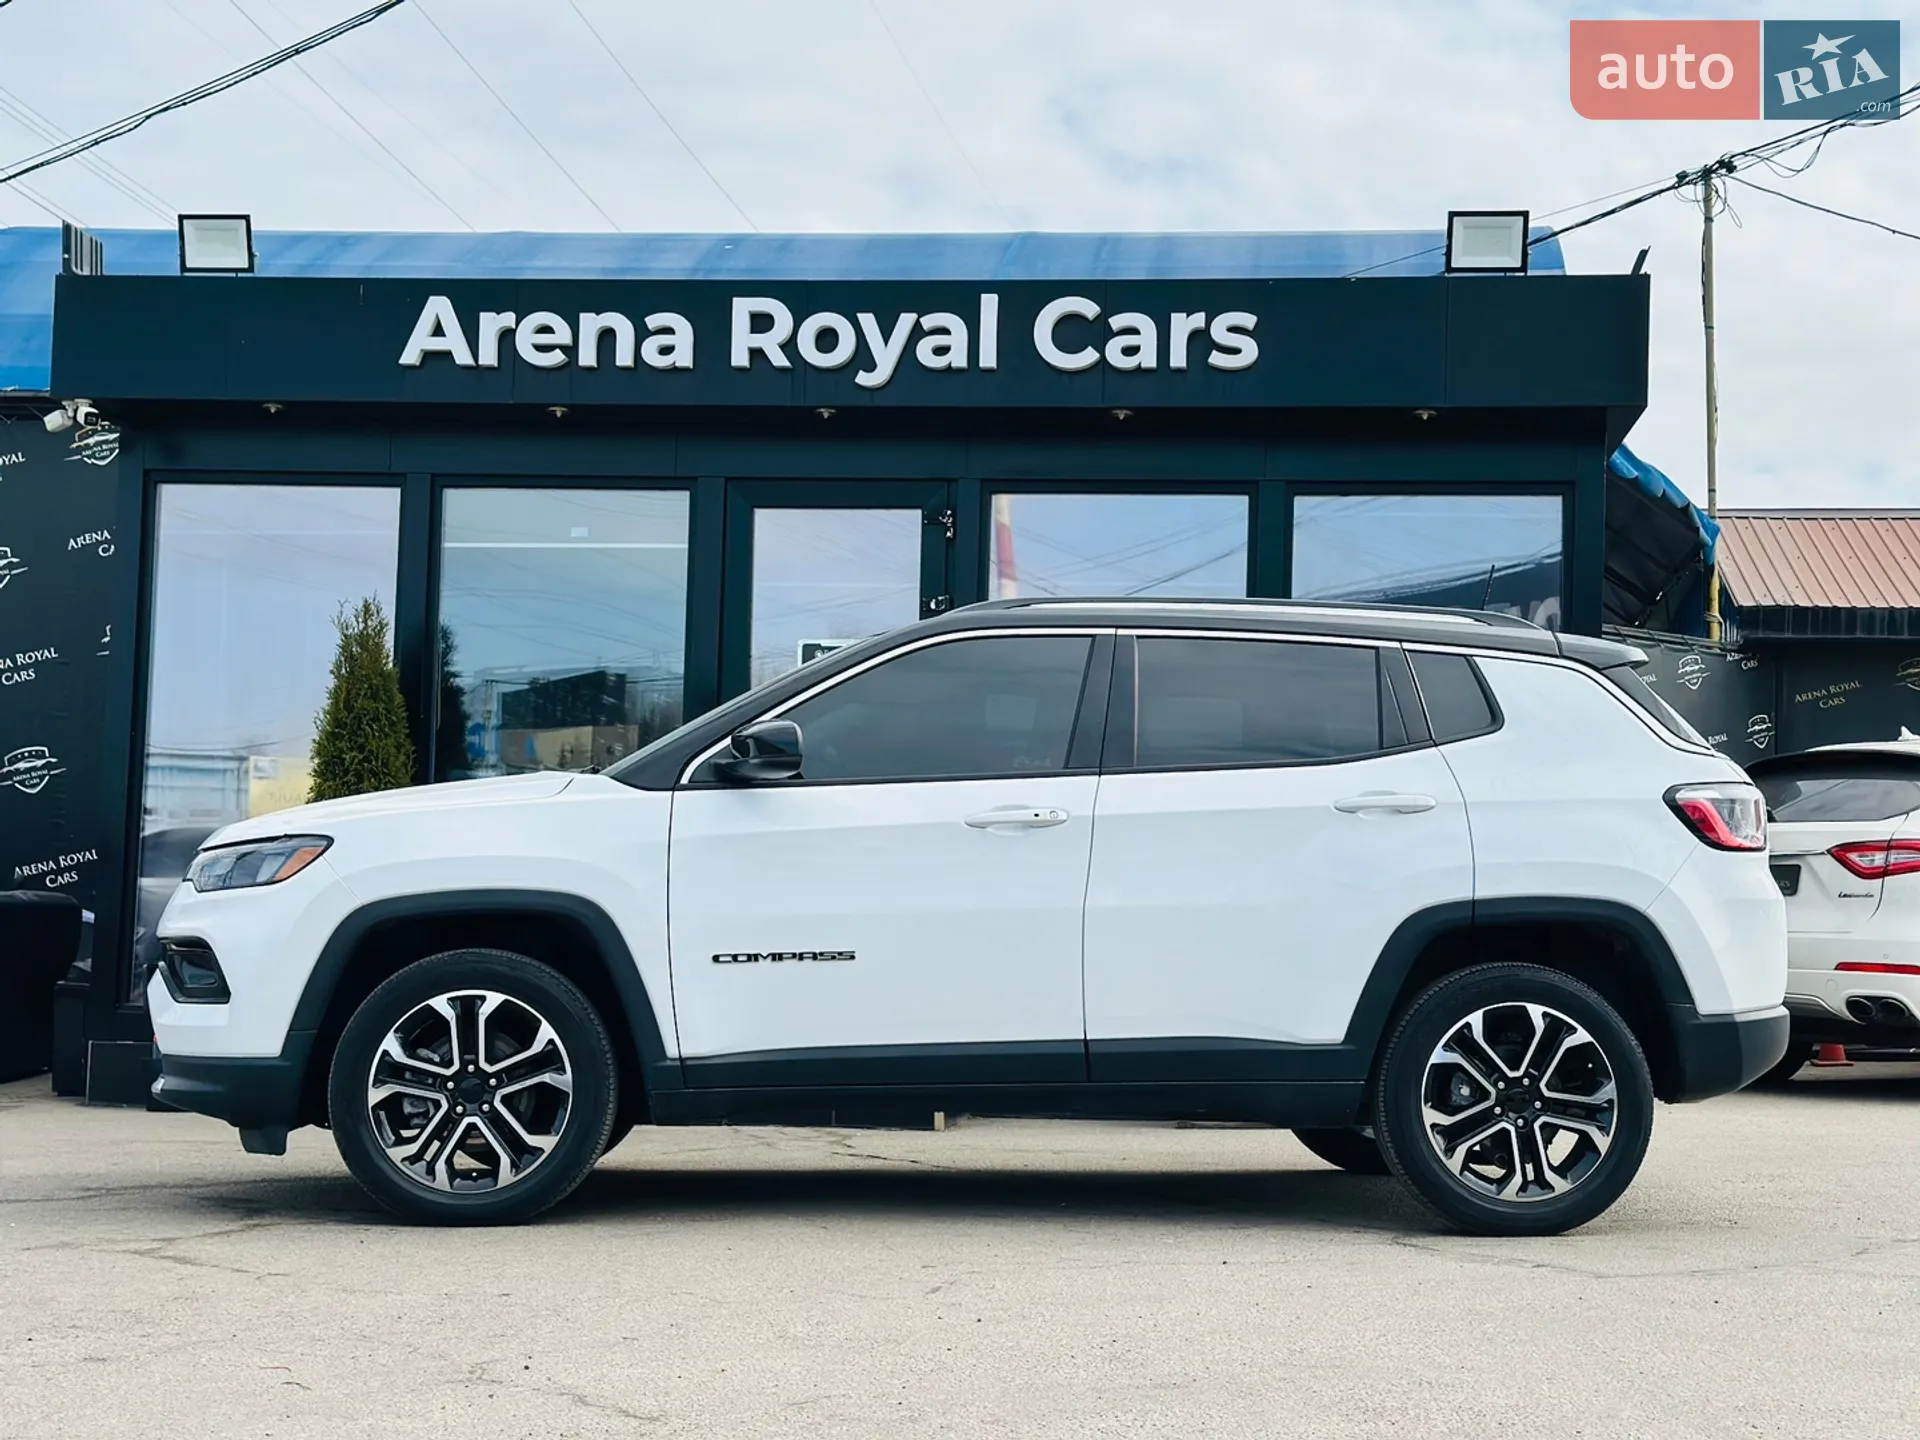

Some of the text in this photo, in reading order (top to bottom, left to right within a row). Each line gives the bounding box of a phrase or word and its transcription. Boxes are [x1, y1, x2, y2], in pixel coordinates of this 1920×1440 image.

[398, 292, 1260, 388] Arena Royal Cars
[0, 451, 26, 466] YAL
[67, 529, 111, 551] ARENA
[15, 647, 59, 666] ROYAL
[1, 668, 36, 685] CARS
[1794, 680, 1862, 703] ARENA ROYAL
[1819, 696, 1846, 709] CARS
[13, 848, 98, 879] ARENA ROYAL
[45, 870, 79, 888] CARS
[711, 950, 856, 964] COMPASS
